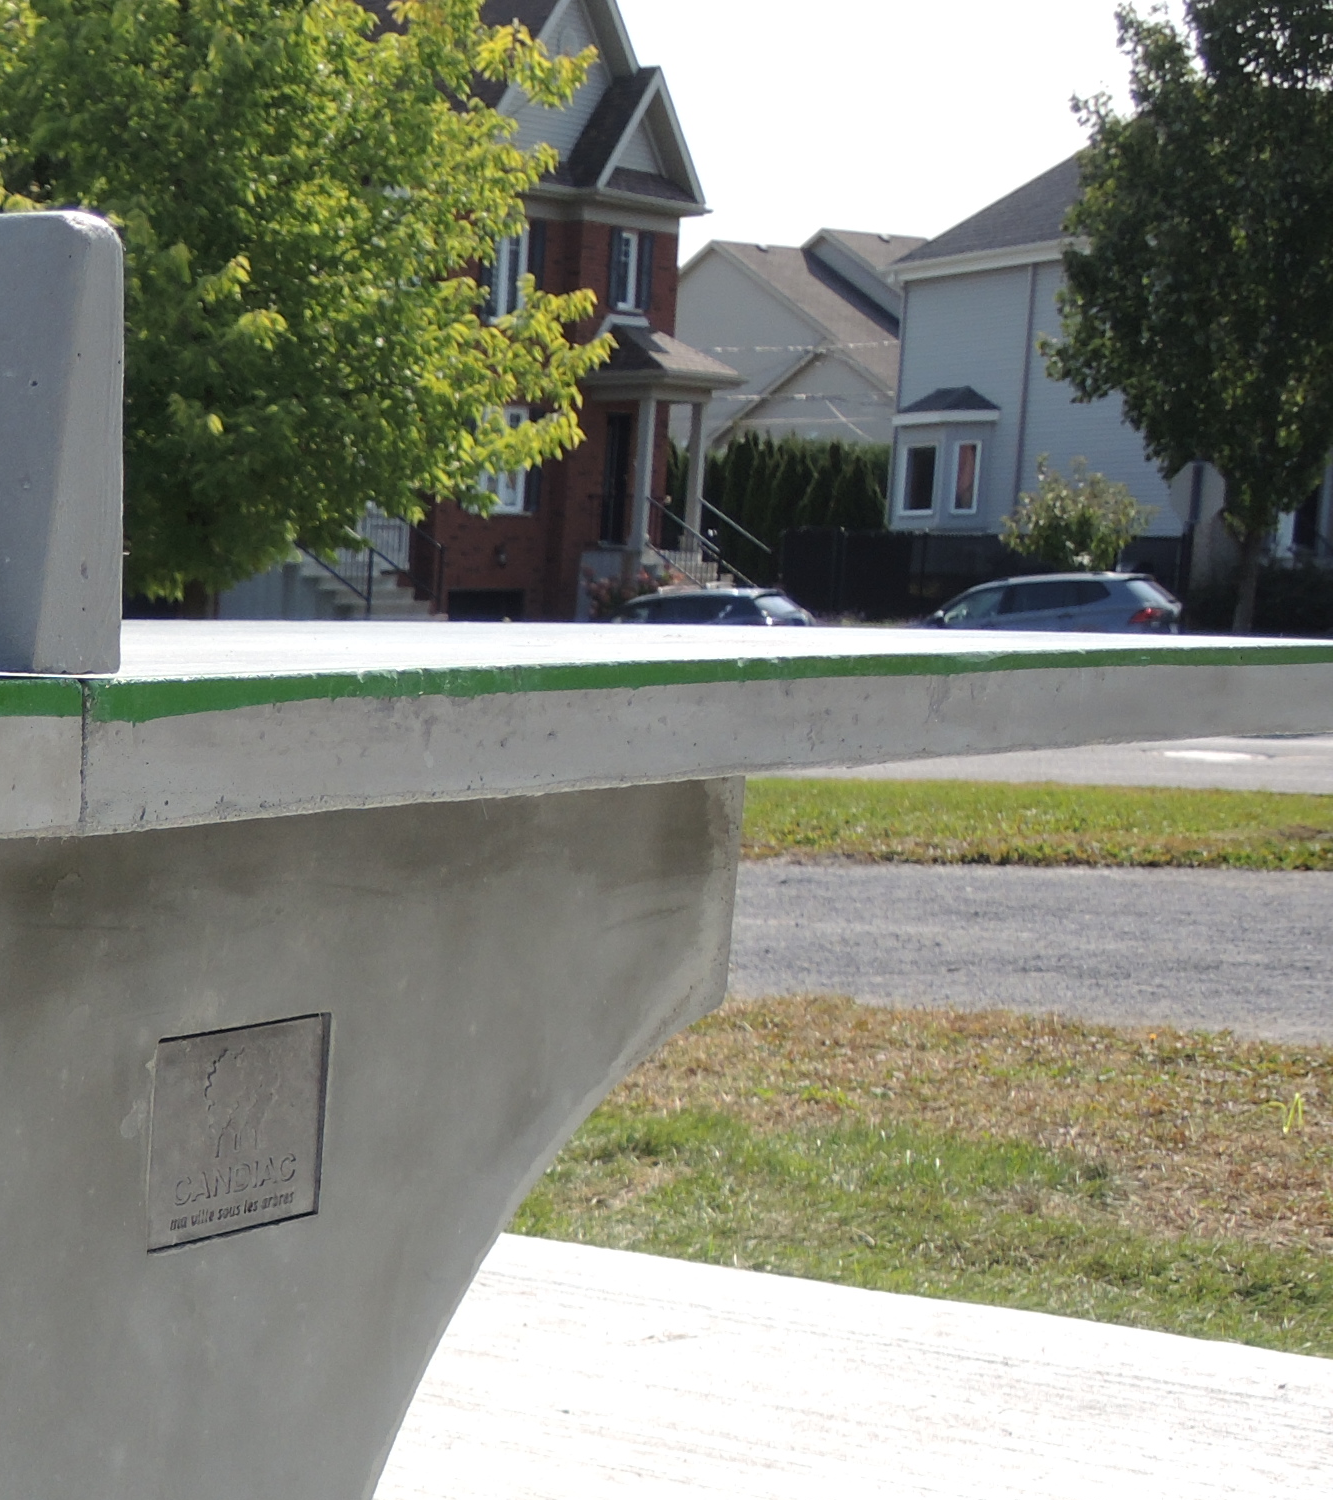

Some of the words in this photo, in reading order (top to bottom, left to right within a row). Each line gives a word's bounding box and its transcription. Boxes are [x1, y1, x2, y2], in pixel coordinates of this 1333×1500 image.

[174, 1153, 297, 1206] CANDIAC
[191, 1208, 215, 1226] ville
[217, 1204, 241, 1220] sous
[244, 1199, 258, 1214] les
[261, 1191, 295, 1210] arbres
